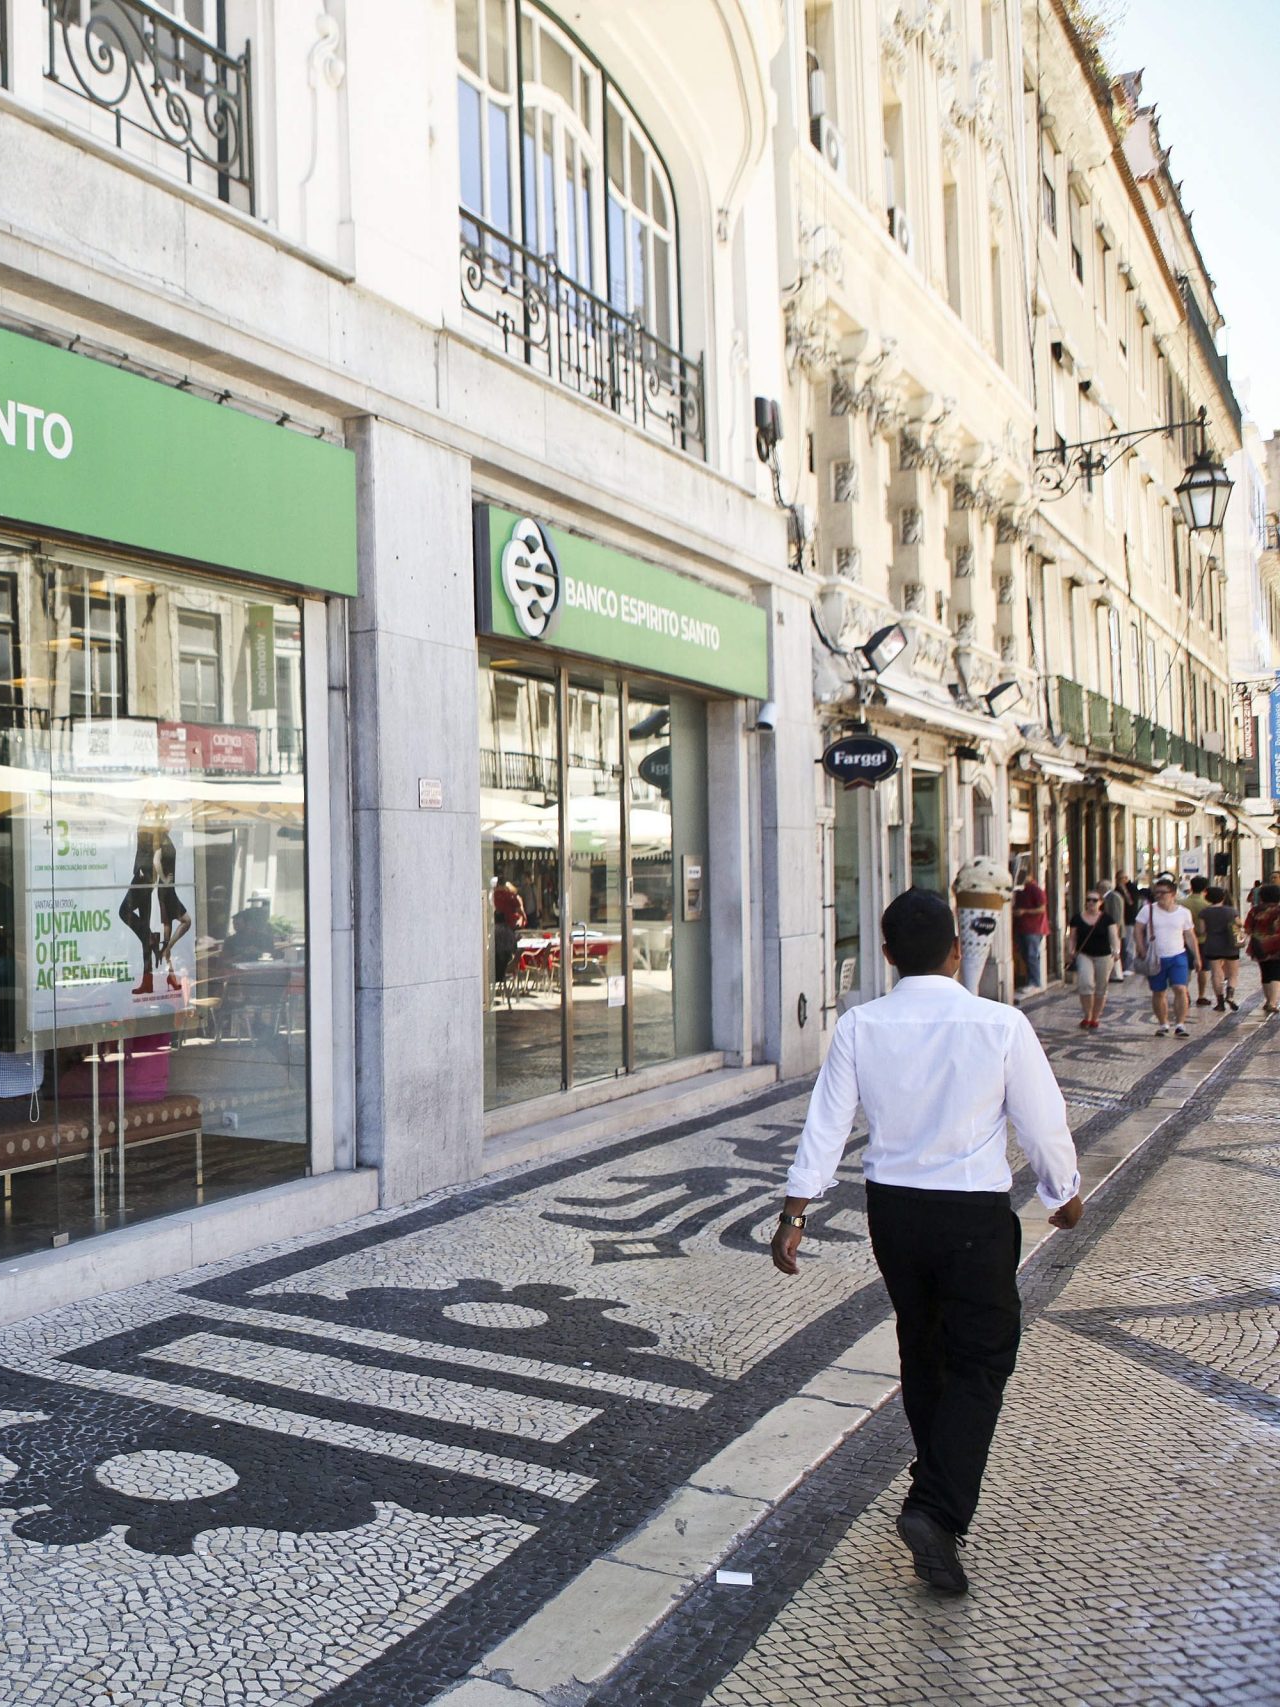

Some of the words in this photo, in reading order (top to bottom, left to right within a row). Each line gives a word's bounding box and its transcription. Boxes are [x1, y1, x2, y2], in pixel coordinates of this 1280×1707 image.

[565, 576, 617, 618] BANCO
[621, 594, 679, 637] ESPIRITO
[681, 616, 720, 650] SANTO
[834, 750, 887, 767] Farggi
[56, 820, 70, 856] 3
[35, 904, 111, 940] JUNTÁMOS
[36, 942, 47, 964] O
[50, 934, 81, 964] ÚTIL
